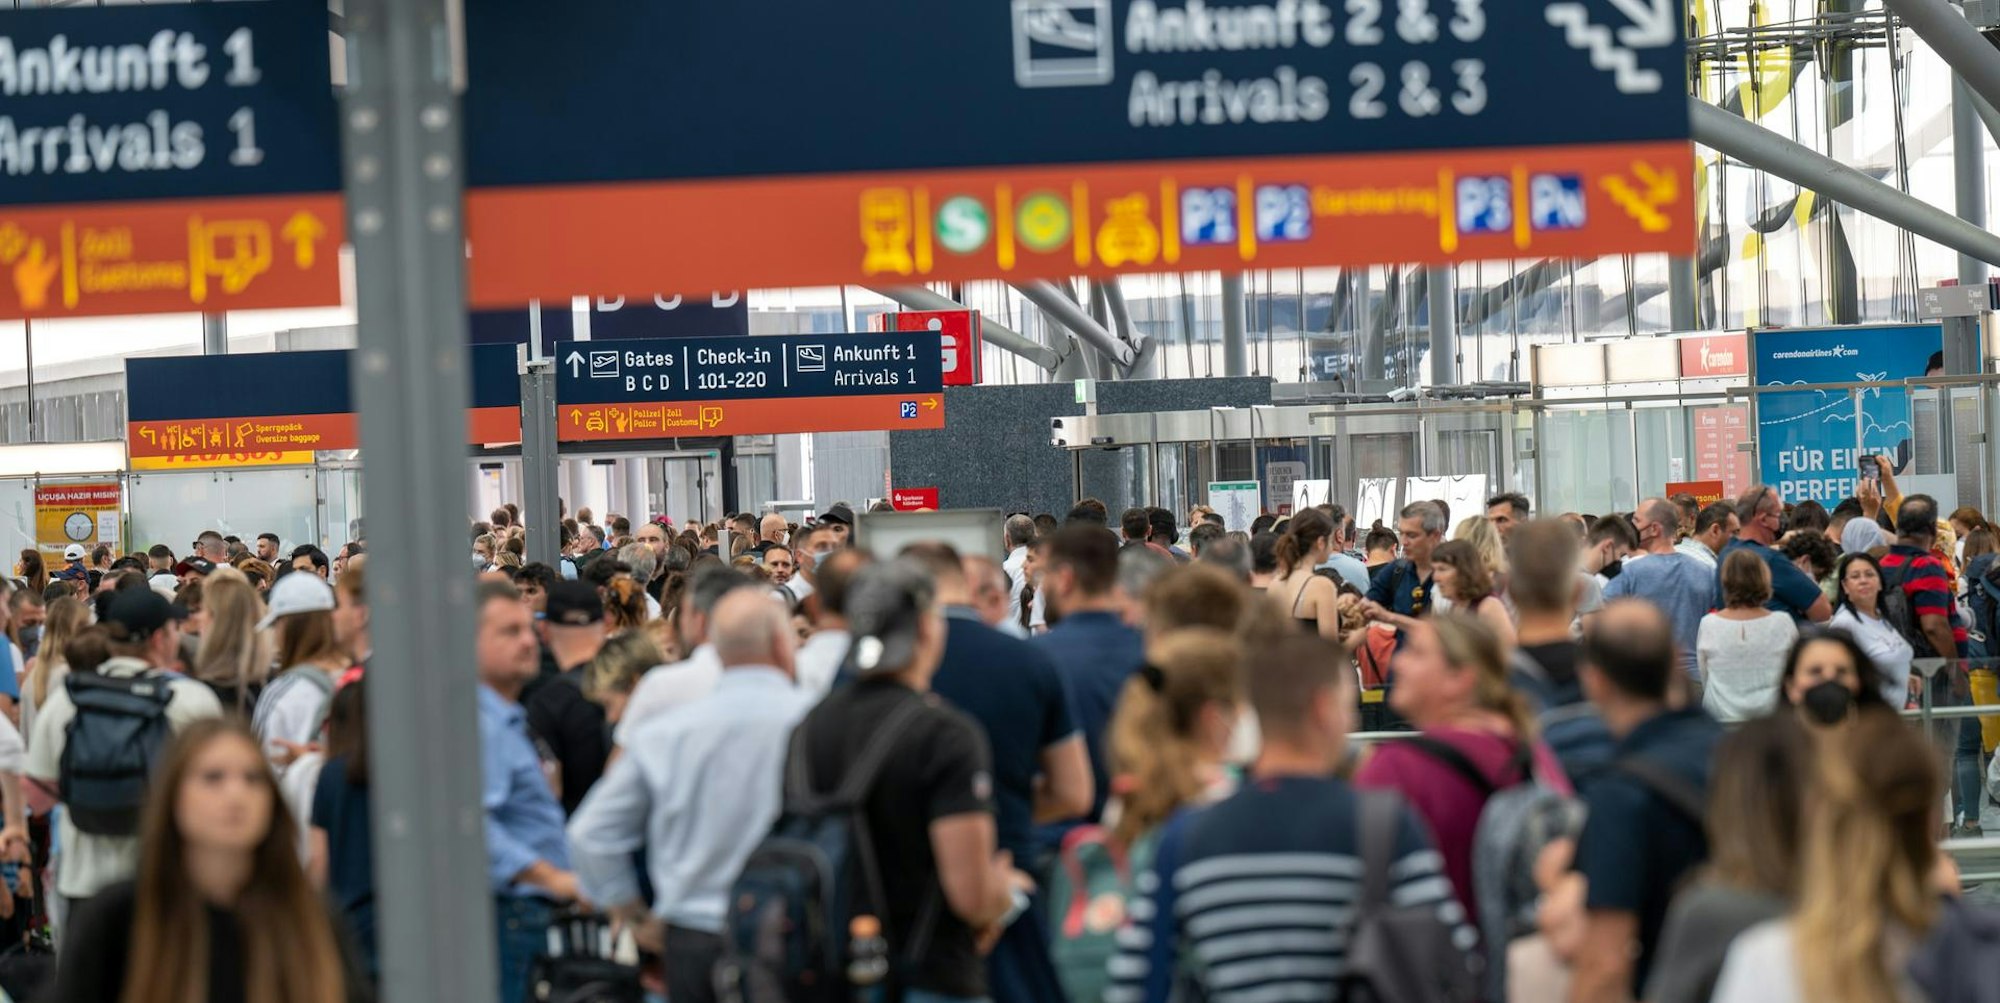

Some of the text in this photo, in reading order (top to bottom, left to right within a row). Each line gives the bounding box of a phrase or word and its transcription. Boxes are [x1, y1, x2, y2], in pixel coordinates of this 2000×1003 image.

[1126, 0, 1486, 52] Ankunft 2 & 3
[0, 26, 262, 96] Ankunft 1
[1128, 58, 1488, 126] Arrivals 2 & 3
[0, 106, 265, 176] Arrivals 1
[625, 351, 674, 367] Gates
[697, 347, 771, 365] Check-in
[834, 344, 916, 361] Ankunft 1
[626, 374, 670, 391] B C D
[698, 371, 767, 389] 101-220
[834, 368, 917, 386] Arrivals 1
[634, 409, 660, 418] Polizei
[667, 408, 682, 417] Zoll
[167, 425, 178, 434] WC
[256, 424, 303, 433] Sperrgepäck
[667, 418, 698, 427] Customs
[256, 433, 320, 443] Oversize baggage
[1778, 445, 1899, 472] FÜR EIN
[38, 493, 65, 502] UÇUŞA
